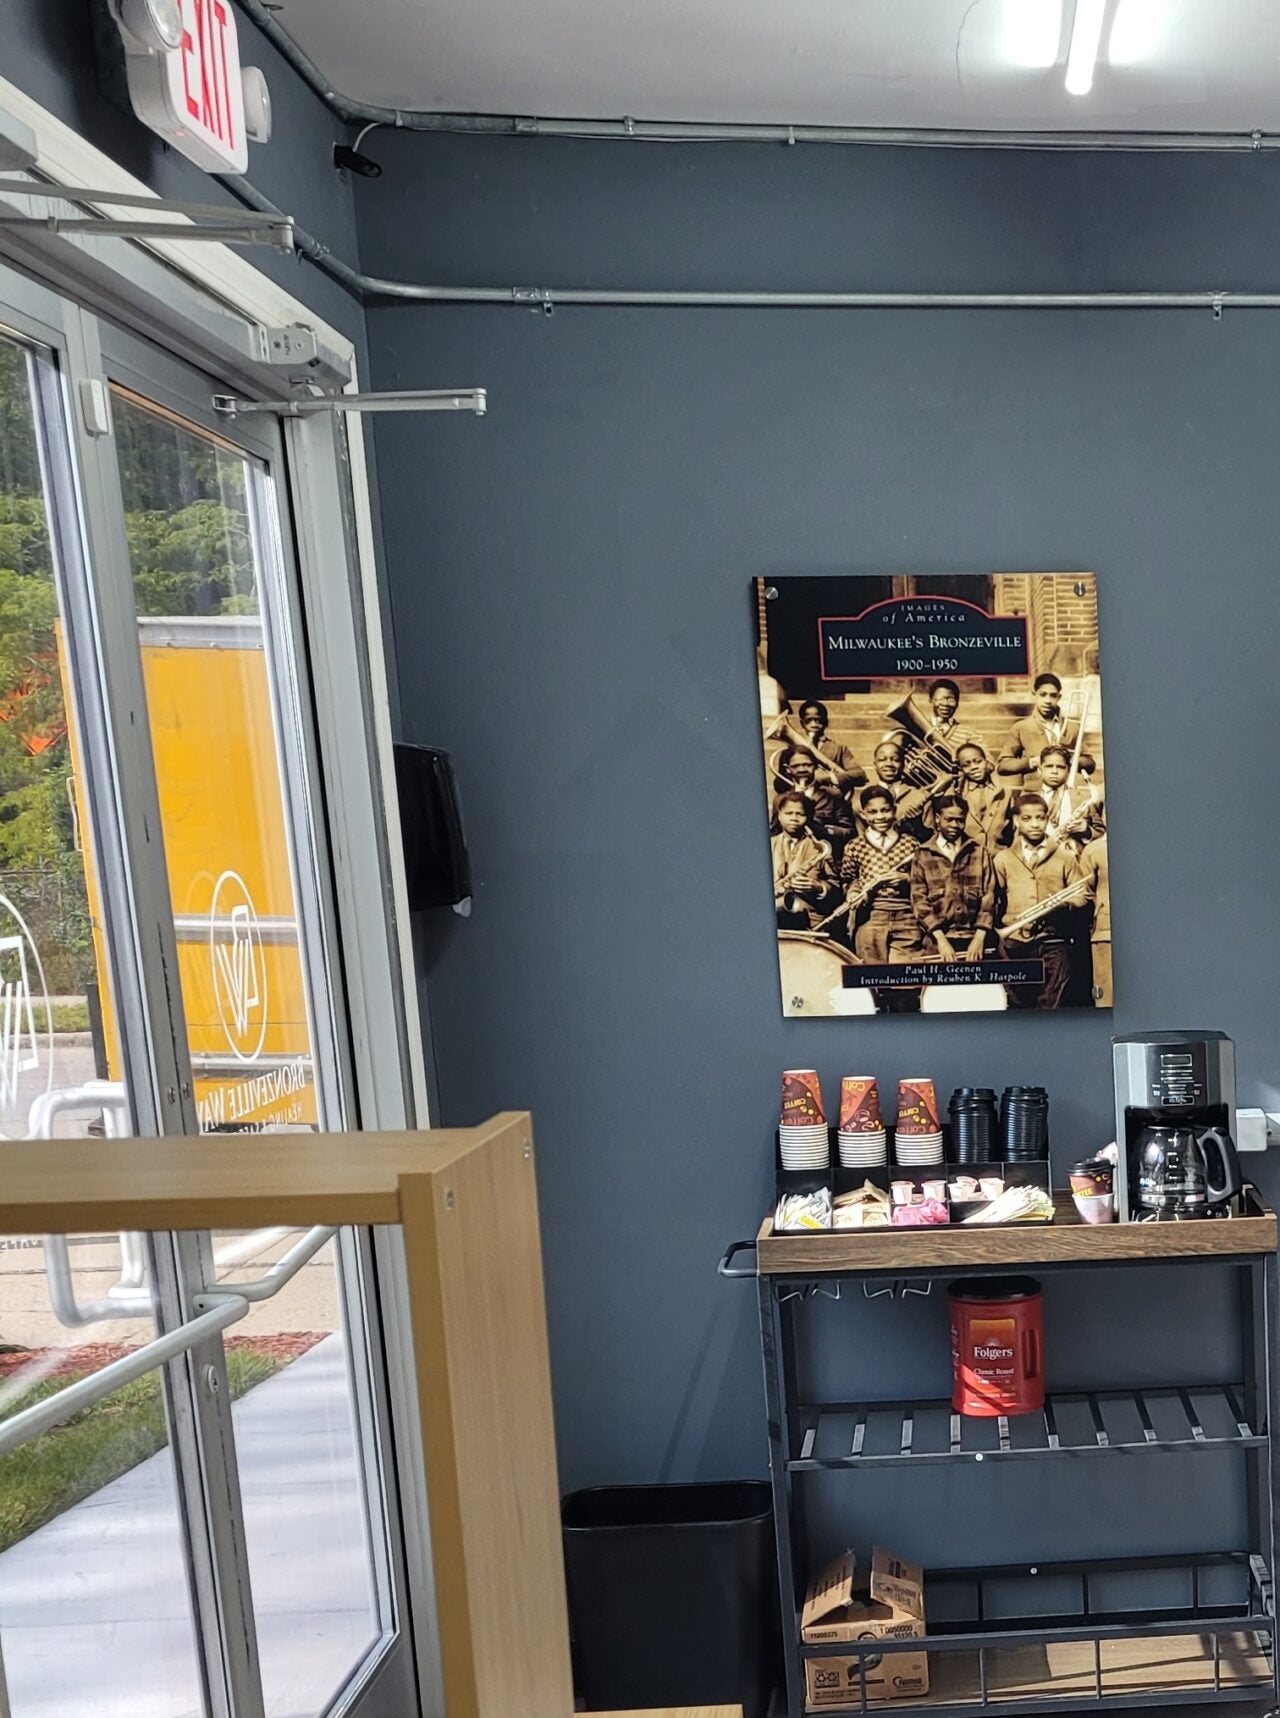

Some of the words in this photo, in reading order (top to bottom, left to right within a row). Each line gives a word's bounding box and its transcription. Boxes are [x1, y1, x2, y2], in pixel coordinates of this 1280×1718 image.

[177, 0, 235, 151] EXIT
[901, 604, 945, 612] IMAGES
[882, 613, 896, 624] of
[905, 612, 966, 623] America
[828, 635, 924, 650] MILWAUKEE'S
[929, 634, 1022, 648] BRONZEVILLE
[896, 659, 958, 671] 1900-1950
[905, 966, 926, 974] Paul
[946, 965, 981, 974] Geenen
[860, 976, 919, 984] Introduction
[922, 975, 933, 984] by
[936, 974, 971, 983] Reuben
[974, 1347, 1013, 1360] Folgers
